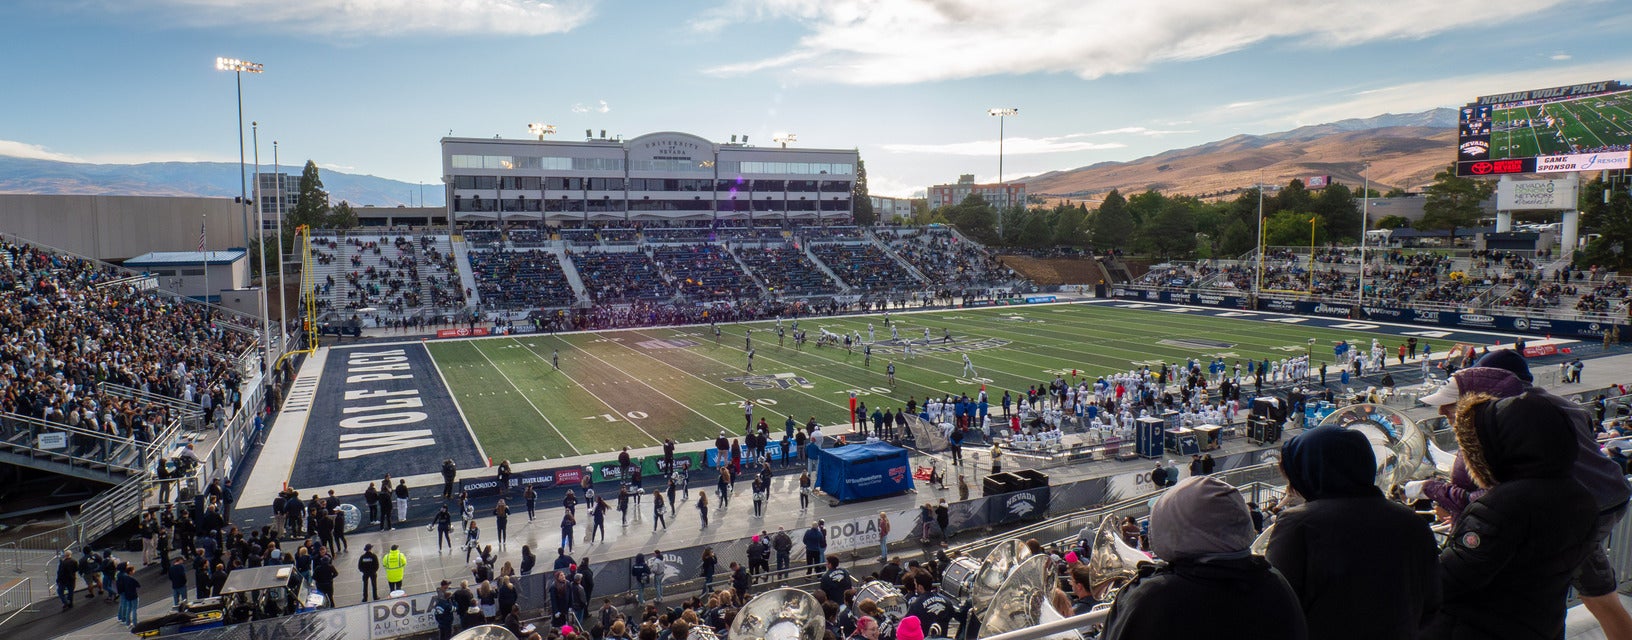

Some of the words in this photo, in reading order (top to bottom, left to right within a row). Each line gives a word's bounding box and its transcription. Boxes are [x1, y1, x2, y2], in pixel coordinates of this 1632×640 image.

[1482, 94, 1528, 105] NEVADA
[1532, 87, 1568, 99] WOLF
[1570, 82, 1608, 95] PACK
[645, 141, 698, 150] UNIVERSITY
[1460, 141, 1489, 149] NEVADA
[1538, 163, 1577, 171] SPONSOR
[1314, 303, 1350, 314] CHAMPION
[1371, 307, 1400, 316] NVEnergy
[347, 349, 414, 384] PACK
[600, 410, 649, 422] 10
[338, 389, 436, 460] WOLF
[464, 481, 497, 491] ELDORADO
[1007, 492, 1036, 507] NEVADA
[831, 537, 854, 547] AUTO
[923, 596, 946, 609] NEVADA
[373, 596, 439, 622] DOLA
[374, 618, 410, 631] AUTO
